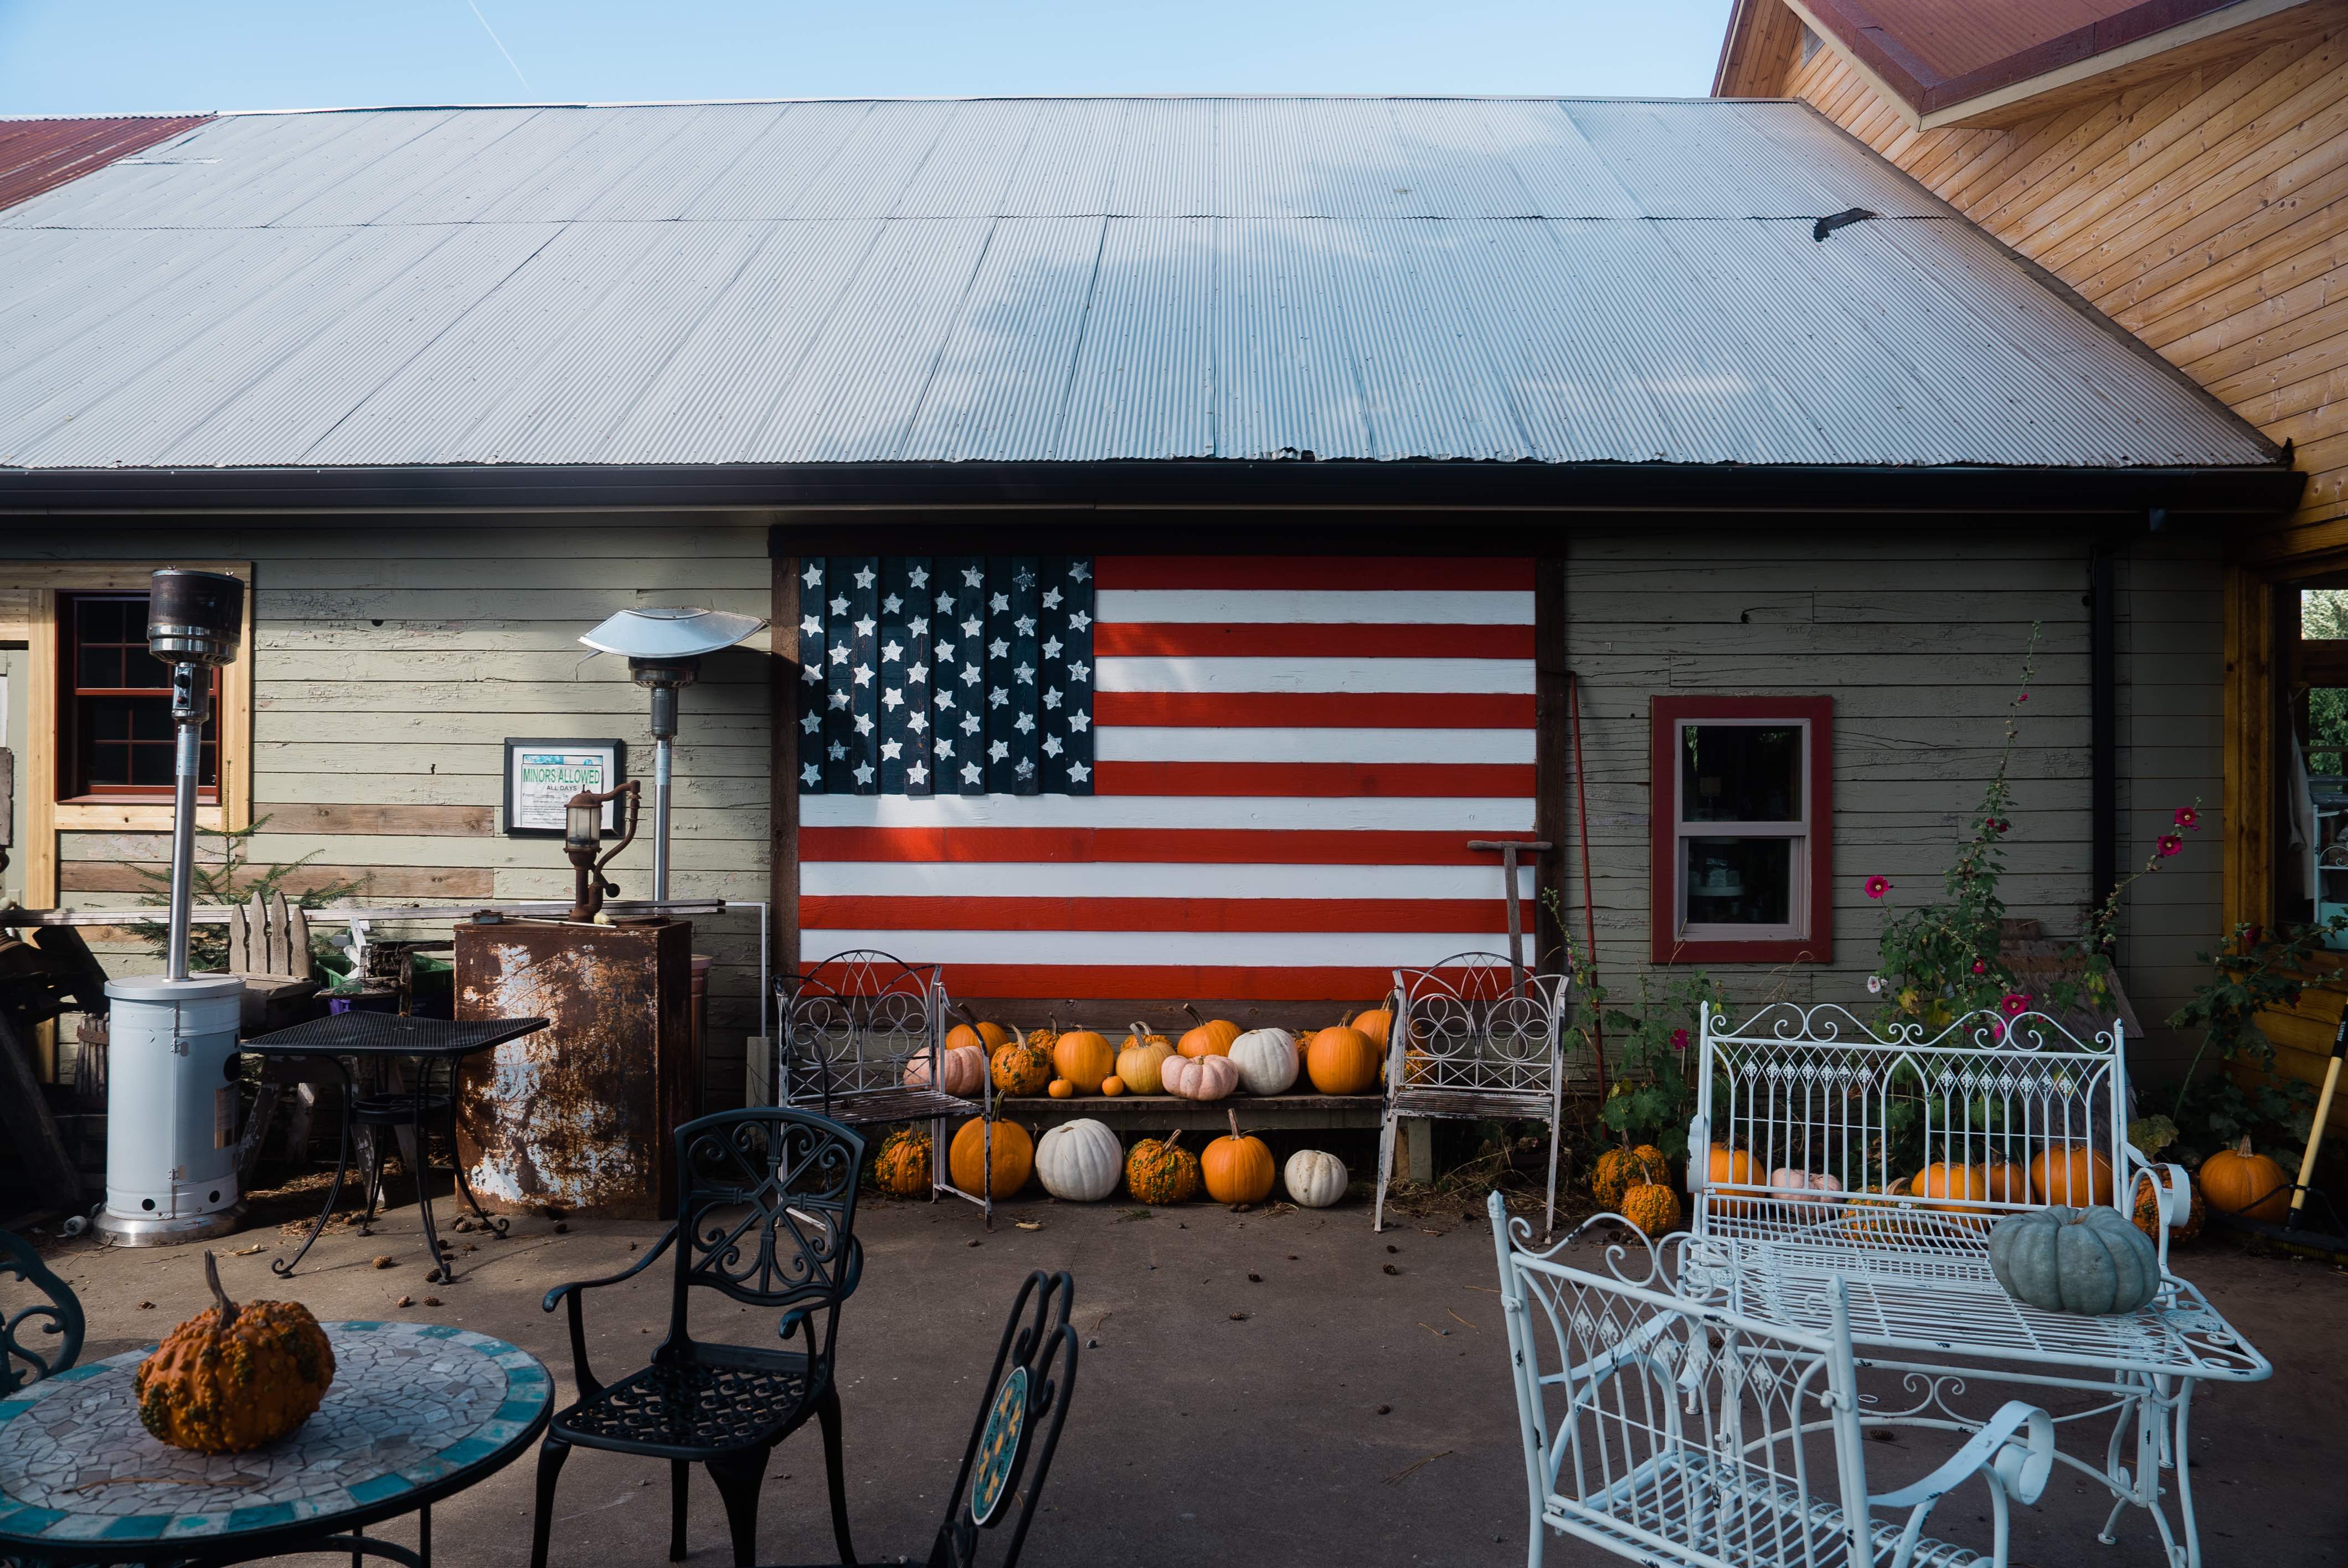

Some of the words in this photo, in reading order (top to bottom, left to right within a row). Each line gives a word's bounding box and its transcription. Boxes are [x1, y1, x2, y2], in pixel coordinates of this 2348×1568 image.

[523, 768, 556, 782] MINORS
[558, 769, 600, 784] ALLOWED
[2336, 1020, 2346, 1041] JOBSITE
